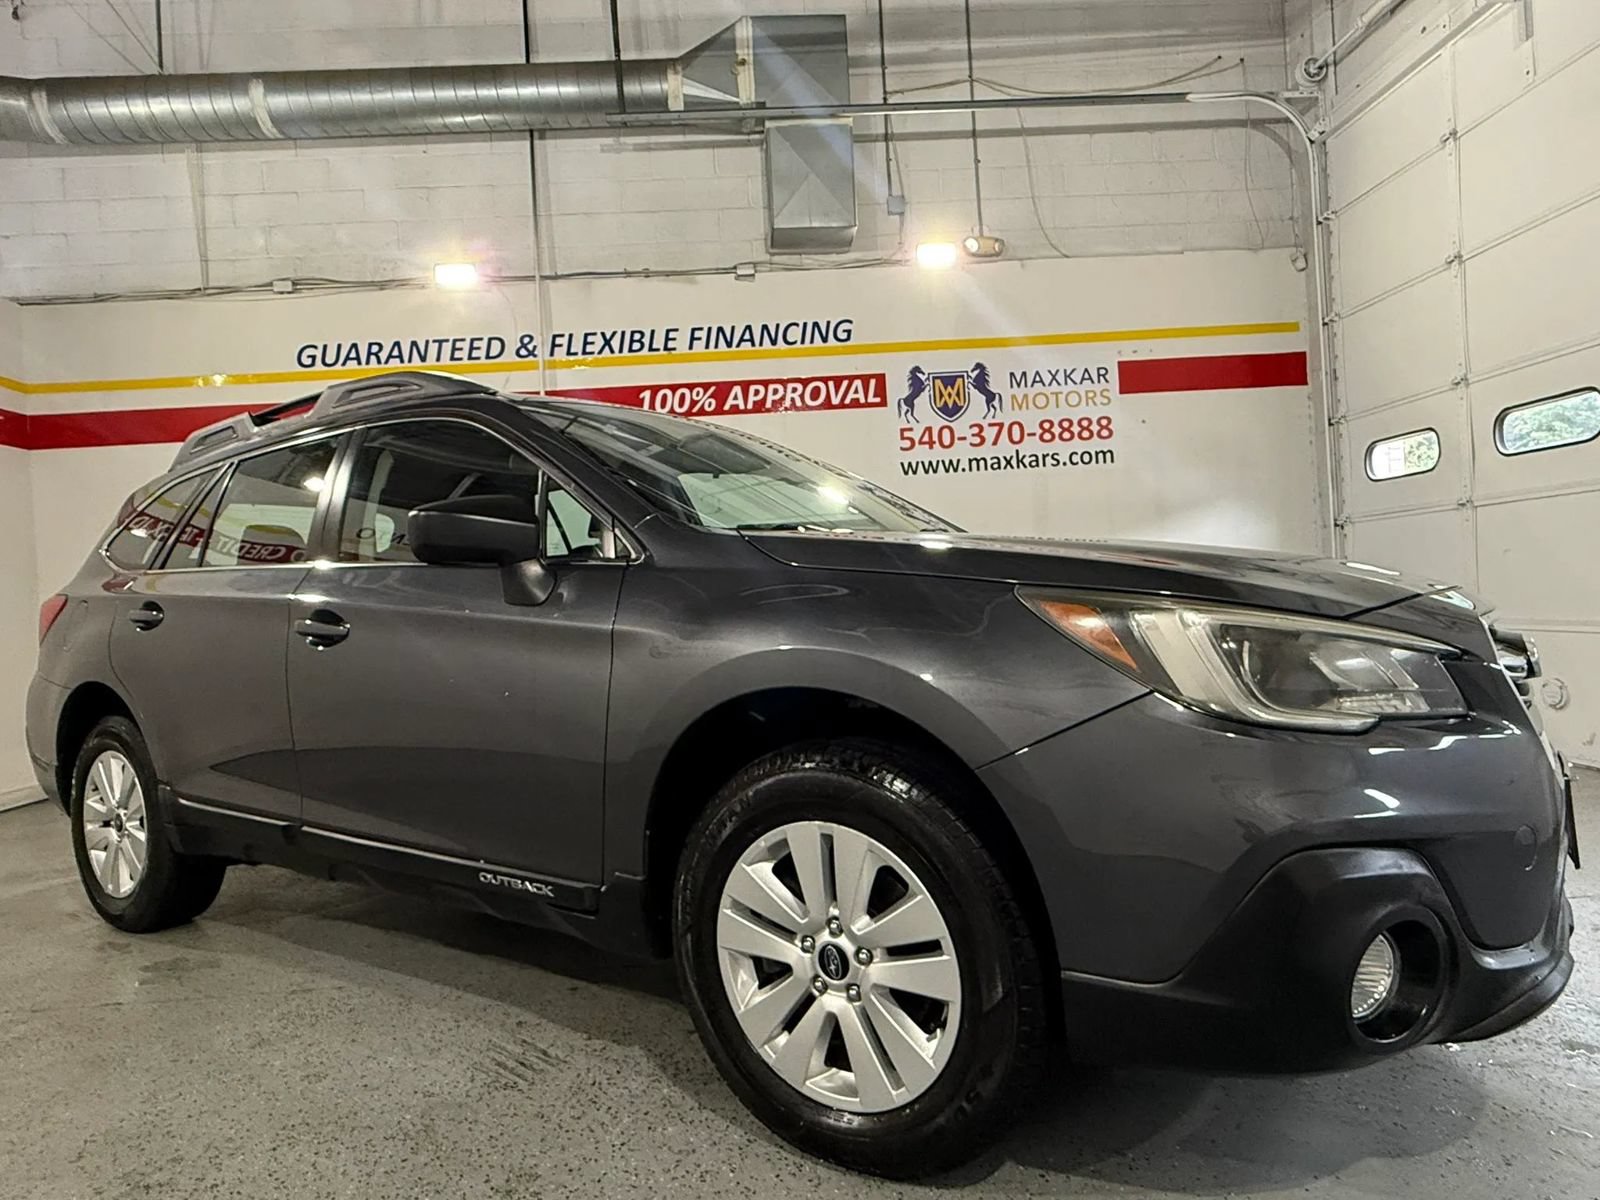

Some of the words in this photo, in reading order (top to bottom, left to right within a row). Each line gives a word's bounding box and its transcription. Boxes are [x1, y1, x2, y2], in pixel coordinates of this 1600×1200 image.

[296, 336, 506, 368] GUARANTEED
[515, 334, 538, 358] &
[549, 328, 679, 356] FLEXIBLE
[688, 319, 853, 350] FINANCING
[1009, 367, 1110, 389] MAXKAR
[639, 386, 716, 414] 100%
[723, 378, 882, 411] APPROVAL
[1011, 388, 1112, 411] MOTORS
[899, 416, 1114, 451] 540-370-8888
[900, 449, 1115, 476] www.maxkars.com
[479, 872, 555, 897] OUTBACK
